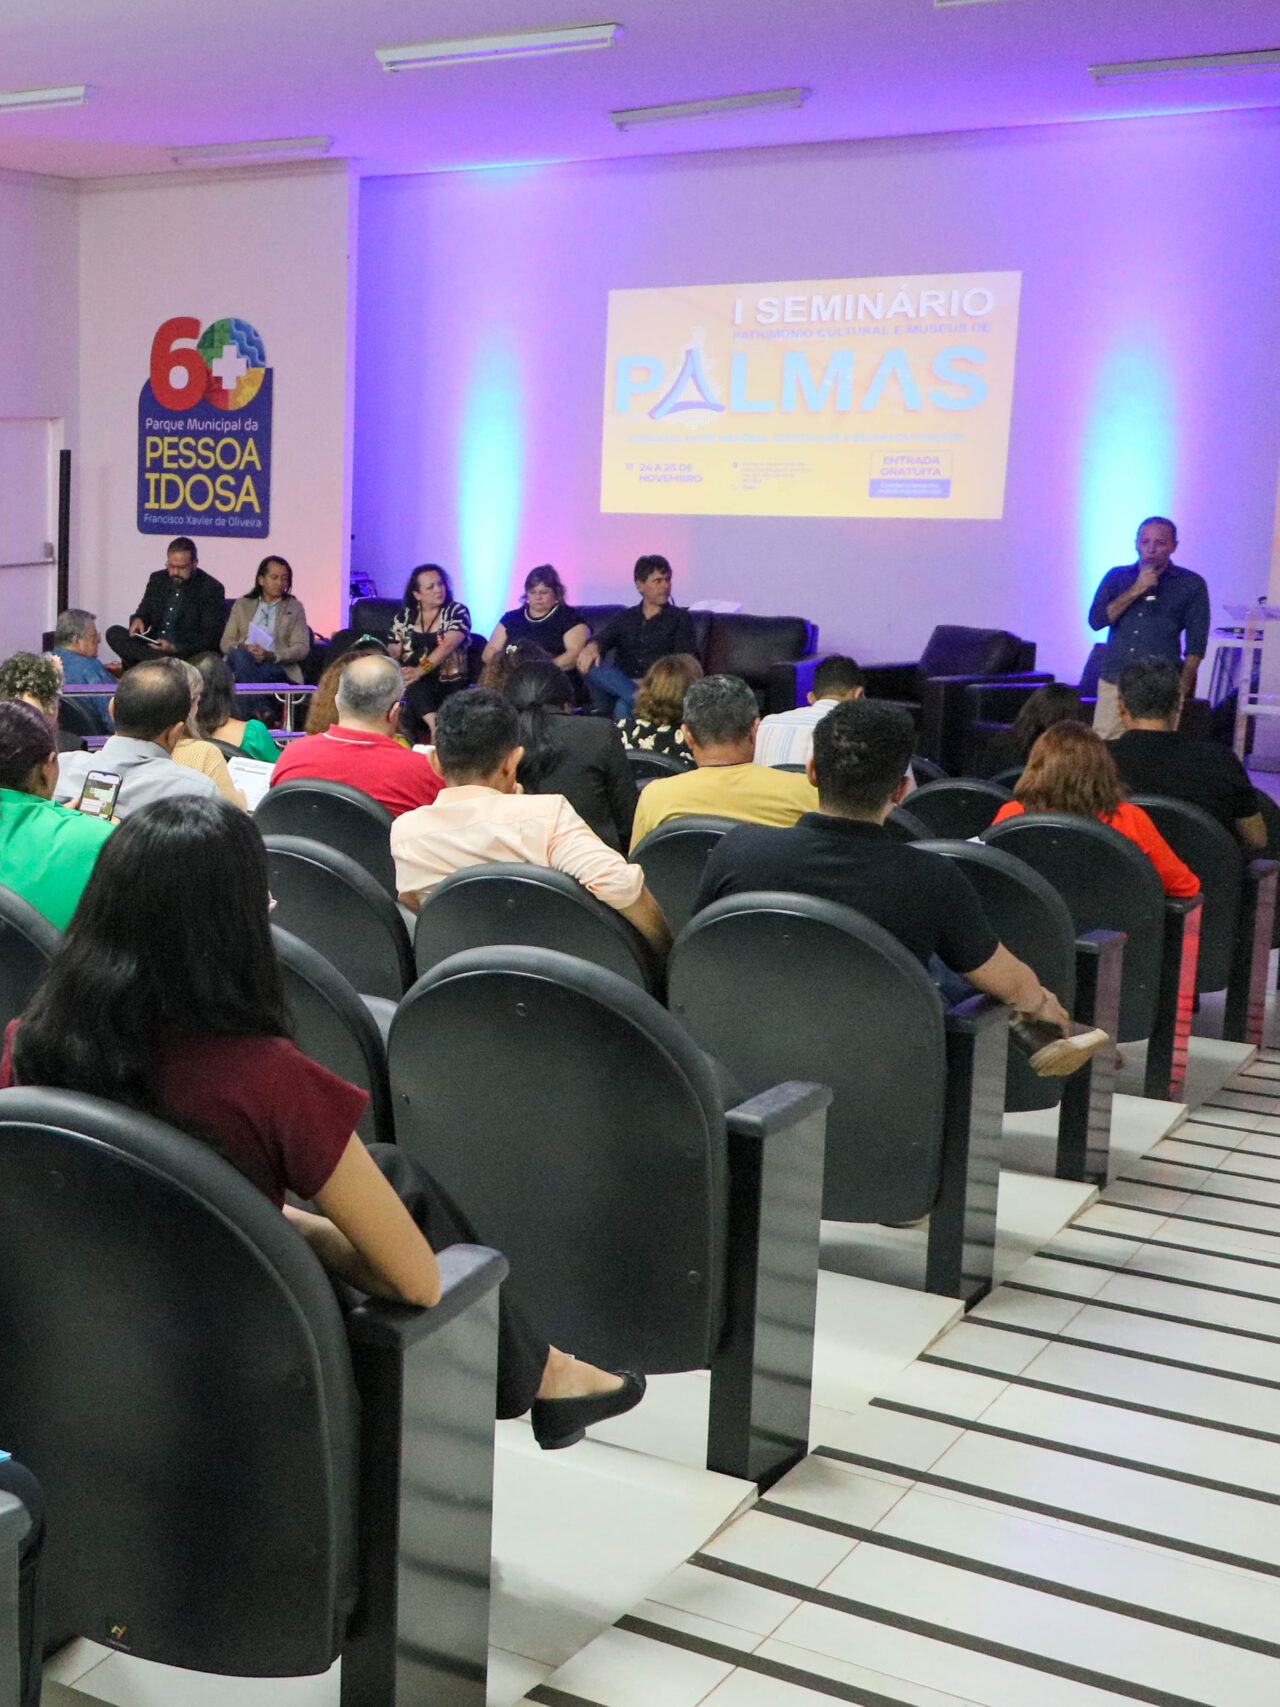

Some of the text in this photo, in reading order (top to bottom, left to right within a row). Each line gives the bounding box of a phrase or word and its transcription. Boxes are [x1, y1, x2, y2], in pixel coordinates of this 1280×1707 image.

[733, 285, 994, 325] I SEMINÁRIO
[817, 325, 889, 337] CULTURAL
[893, 325, 901, 335] E
[907, 323, 967, 334] MUSEUS
[972, 322, 991, 333] DE
[613, 345, 990, 420] PALMAS
[145, 418, 259, 433] Parque Municipal da
[145, 436, 262, 471] PESSOA
[883, 455, 940, 465] ENTRADA
[639, 474, 703, 483] NOVEMBRO
[880, 467, 942, 476] GRATUITA
[144, 473, 261, 513] IDOSA
[143, 513, 262, 528] Francisco Xavier de Oliveira
